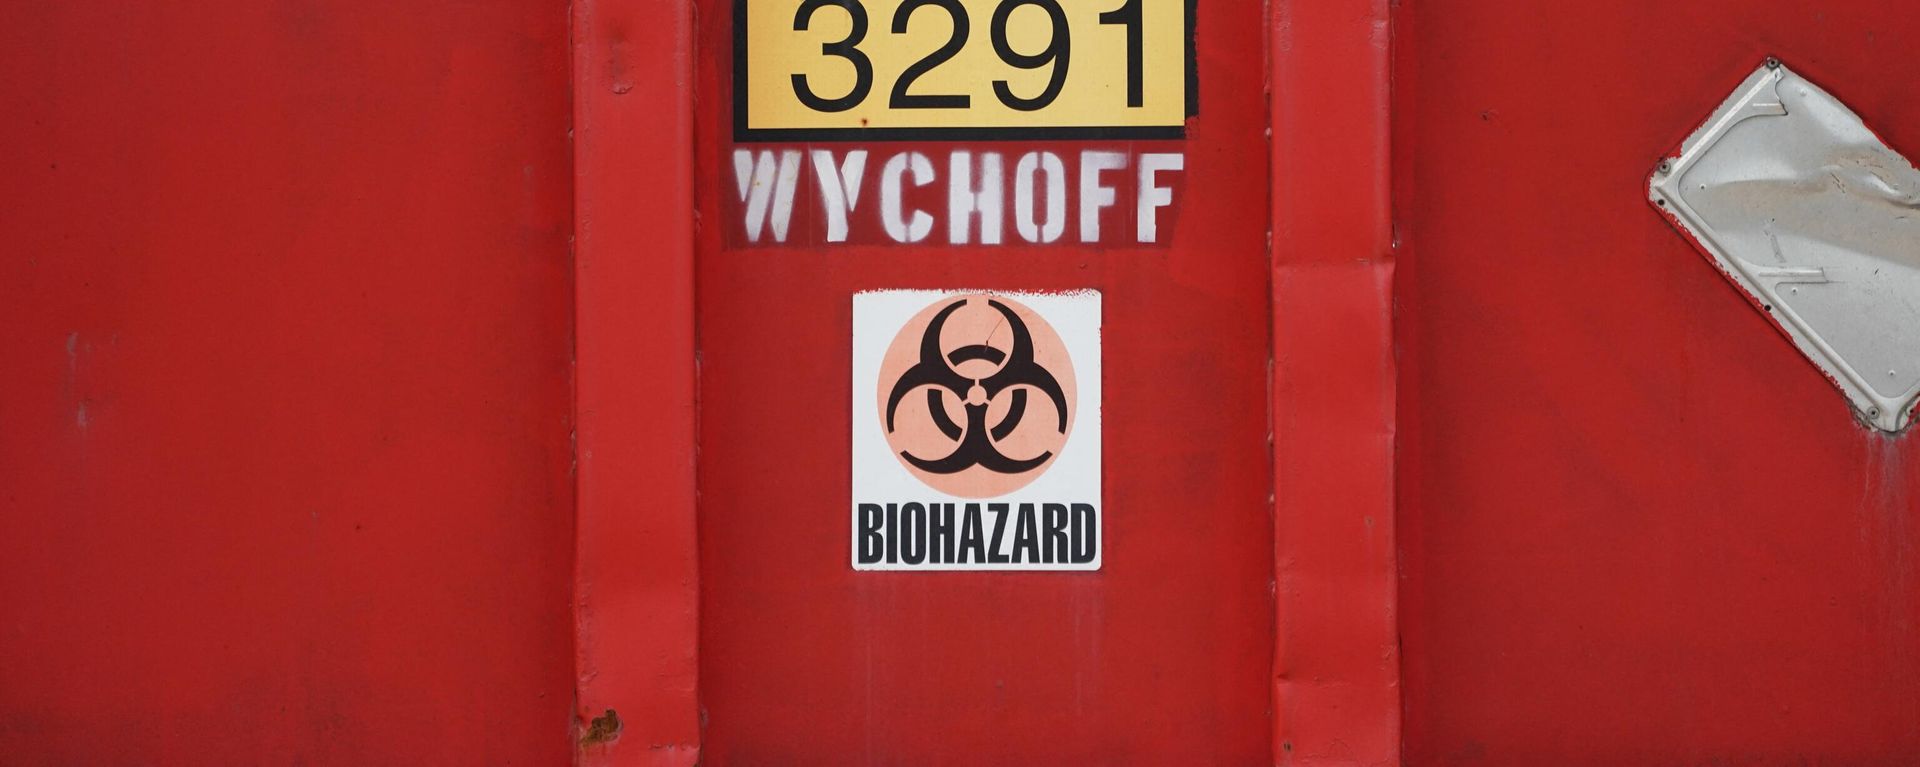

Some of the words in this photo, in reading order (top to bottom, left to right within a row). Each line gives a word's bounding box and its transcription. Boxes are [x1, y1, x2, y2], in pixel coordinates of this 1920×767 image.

[790, 0, 1143, 112] 3291
[733, 150, 1184, 244] WYCHOFF
[858, 502, 1096, 565] BIOHAZARD
